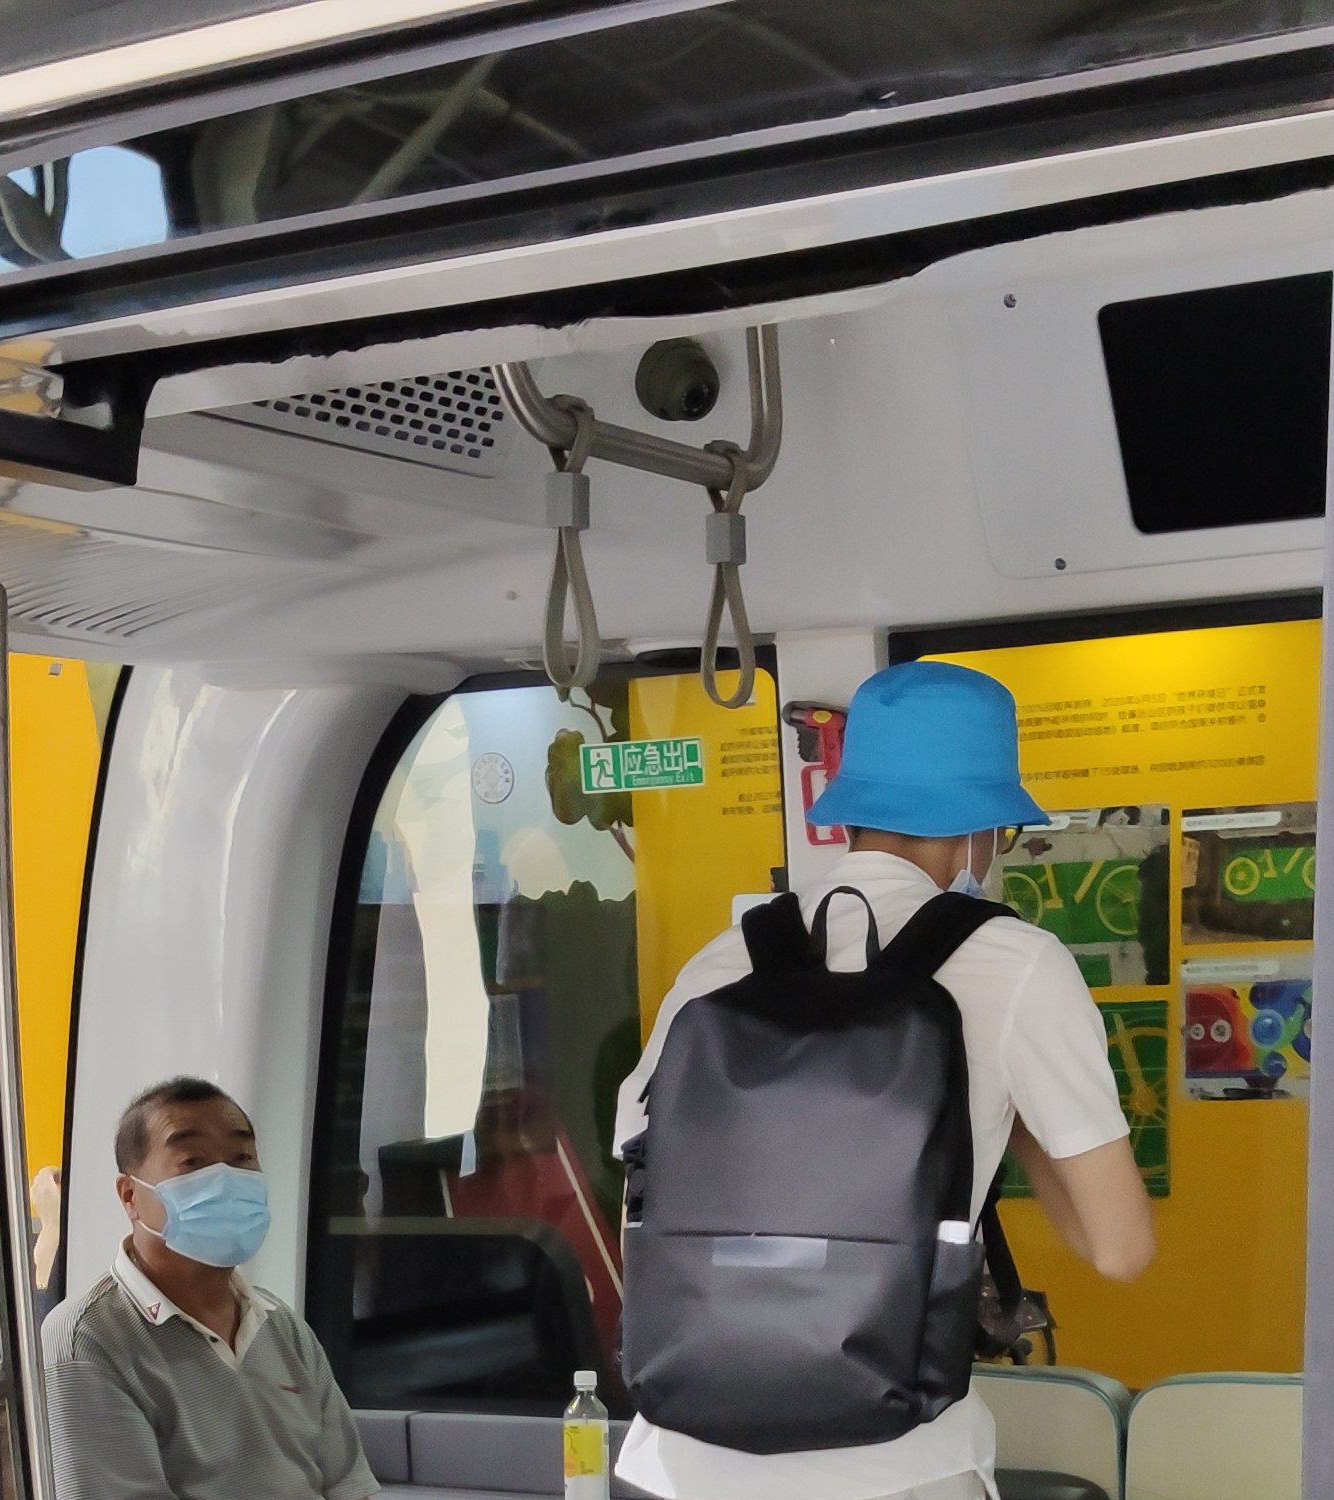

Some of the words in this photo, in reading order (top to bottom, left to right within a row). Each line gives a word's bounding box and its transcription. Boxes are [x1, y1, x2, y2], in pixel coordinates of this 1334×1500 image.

[624, 740, 702, 776] 应急出口
[676, 771, 695, 784] Exit
